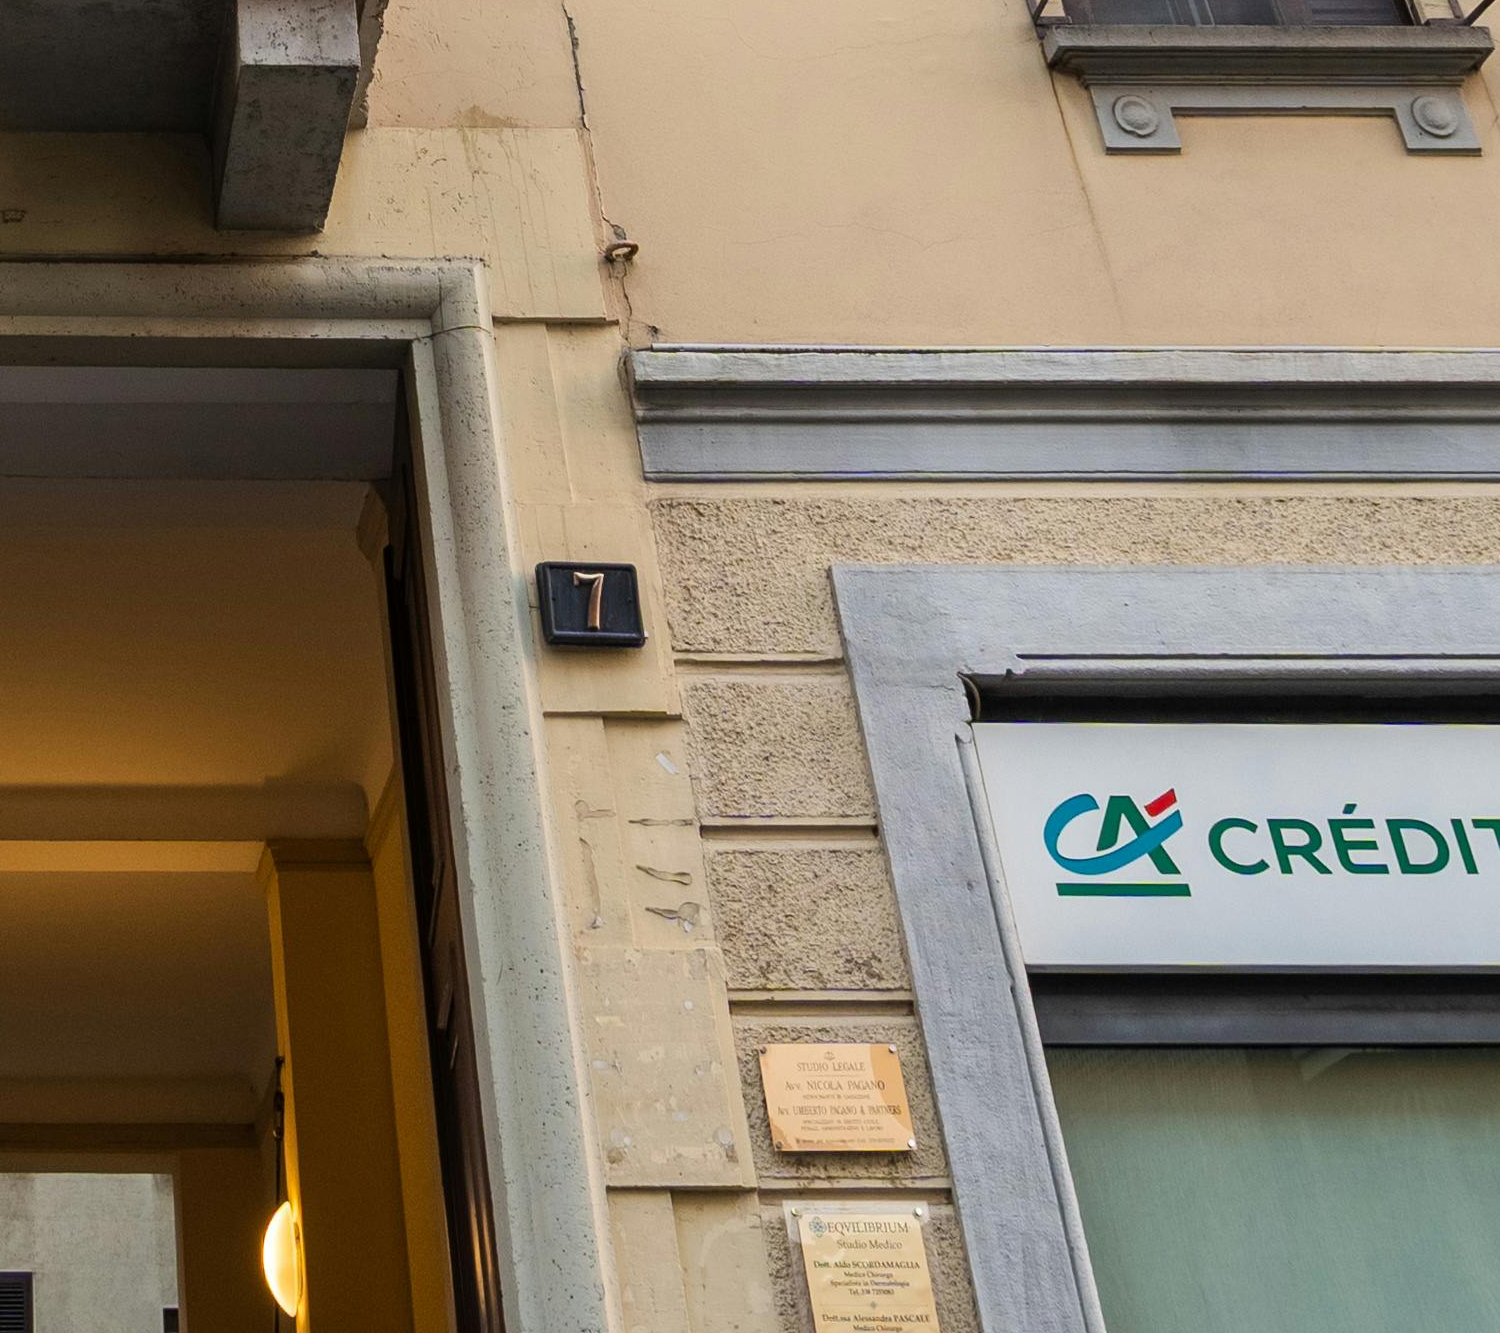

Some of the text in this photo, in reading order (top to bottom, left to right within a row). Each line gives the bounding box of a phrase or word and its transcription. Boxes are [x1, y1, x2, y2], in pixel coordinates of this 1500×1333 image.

[573, 571, 605, 630] 7
[797, 1061, 865, 1071] STUDIO LEGALE
[807, 1080, 842, 1091] NICOLA
[848, 1080, 885, 1091] PAGANO
[793, 1105, 826, 1115] UMBERTO
[869, 1105, 902, 1115] PARTNERS
[828, 1221, 909, 1235] EQVILIBRIUM
[837, 1240, 902, 1249] Studio Medico
[852, 1261, 920, 1269] SCORDAMAGLIA
